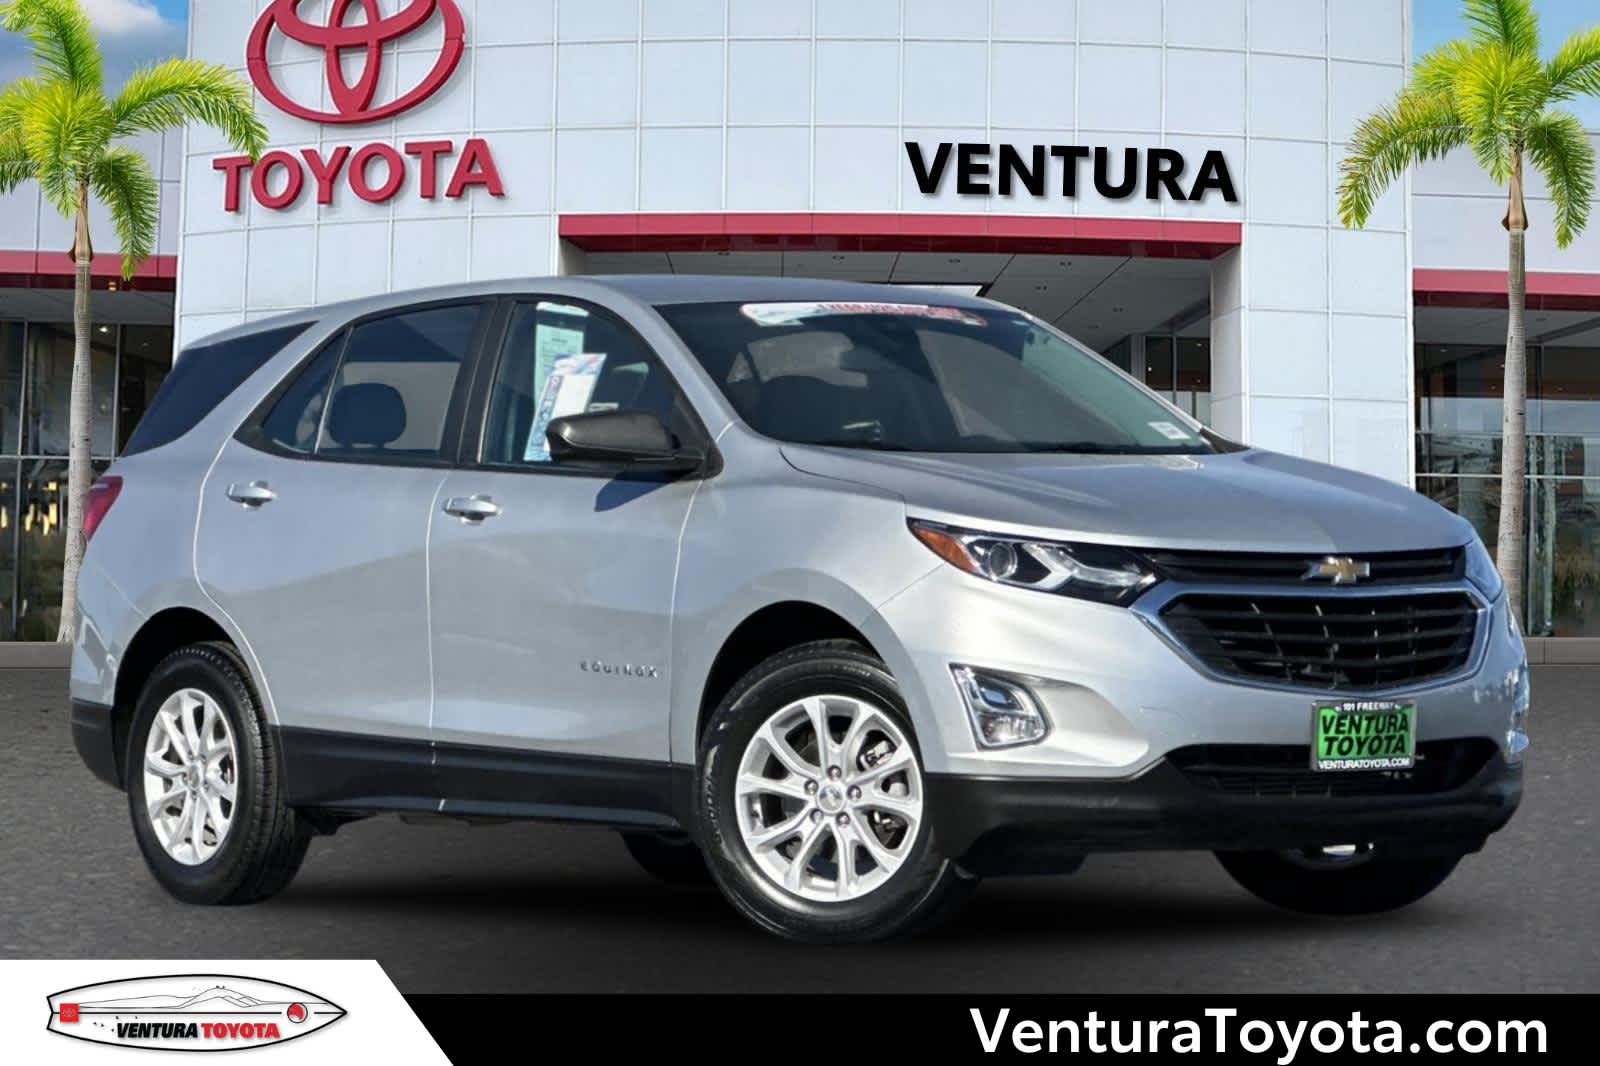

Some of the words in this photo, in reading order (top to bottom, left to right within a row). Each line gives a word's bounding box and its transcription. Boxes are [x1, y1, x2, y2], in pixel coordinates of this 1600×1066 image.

[213, 139, 504, 212] TOYOTA
[905, 142, 1238, 202] VENTURA
[1322, 713, 1408, 734] VENTURA
[1324, 734, 1405, 756] TOYOTA
[1318, 758, 1410, 769] VENTURATOYOTA.COM
